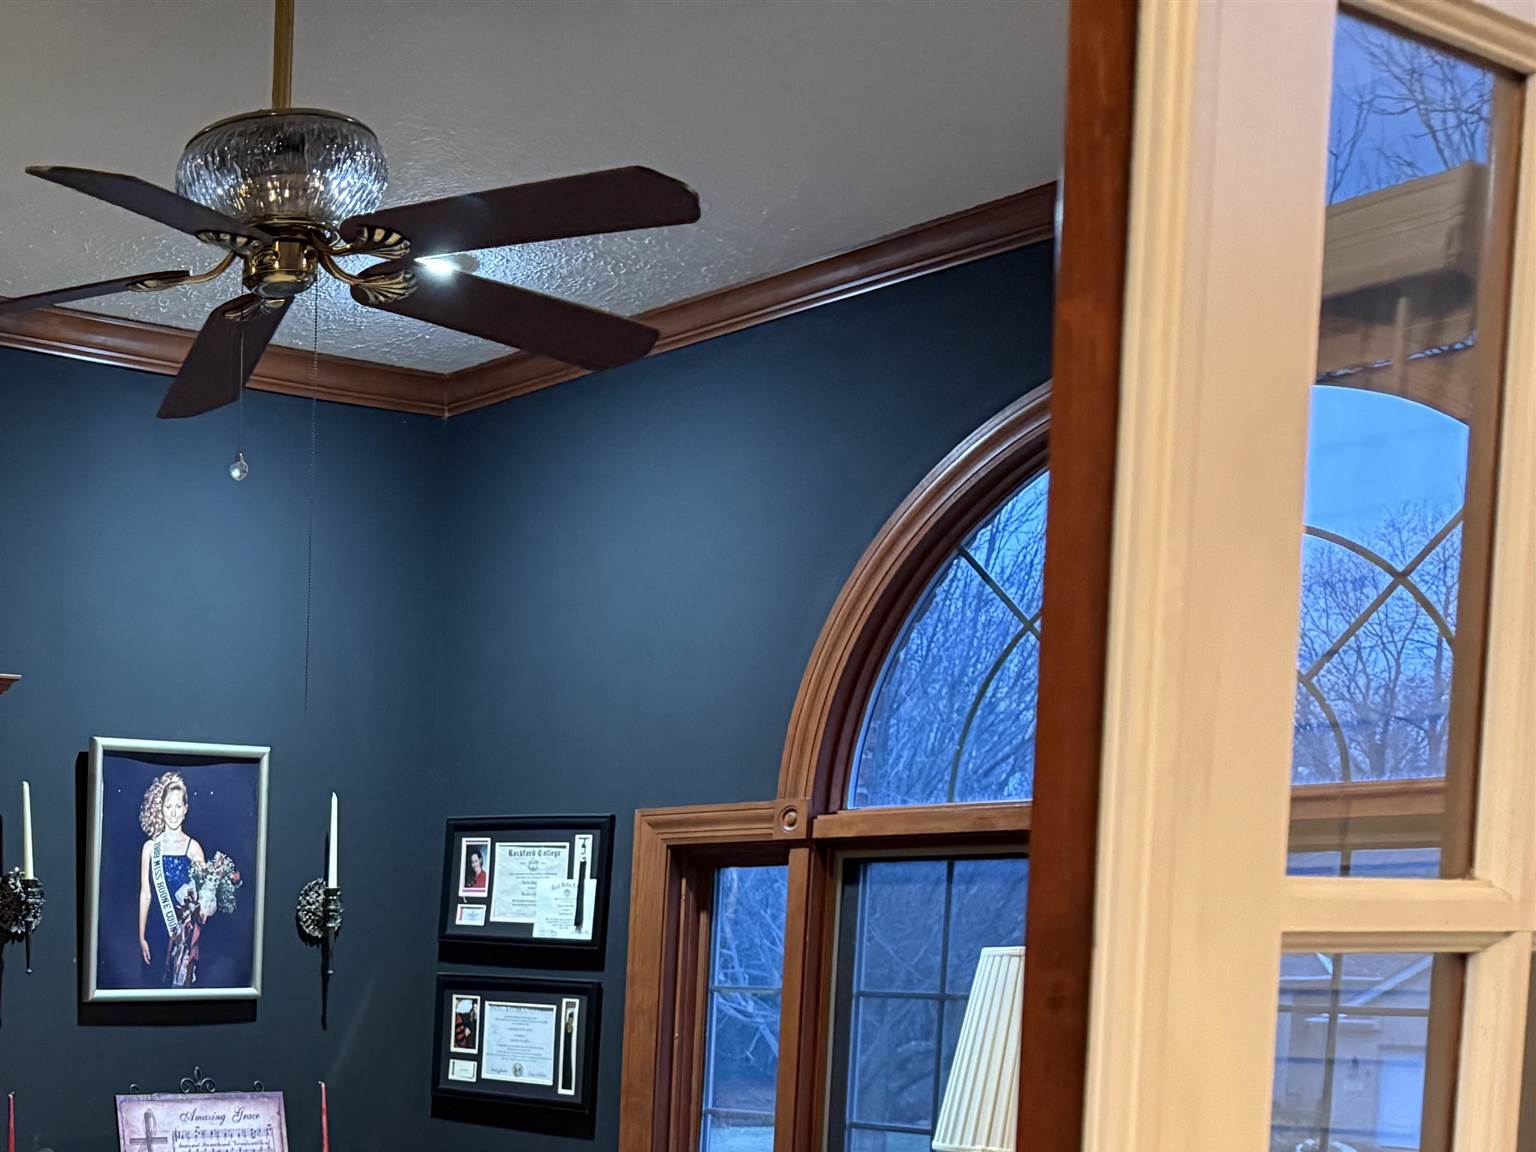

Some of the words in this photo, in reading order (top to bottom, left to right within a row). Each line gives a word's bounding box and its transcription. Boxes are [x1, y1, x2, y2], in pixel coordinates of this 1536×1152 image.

[537, 849, 561, 858] College
[153, 859, 163, 881] MISS
[156, 881, 171, 910] BOONE
[179, 1107, 227, 1127] Amazing
[232, 1105, 261, 1124] Grace
